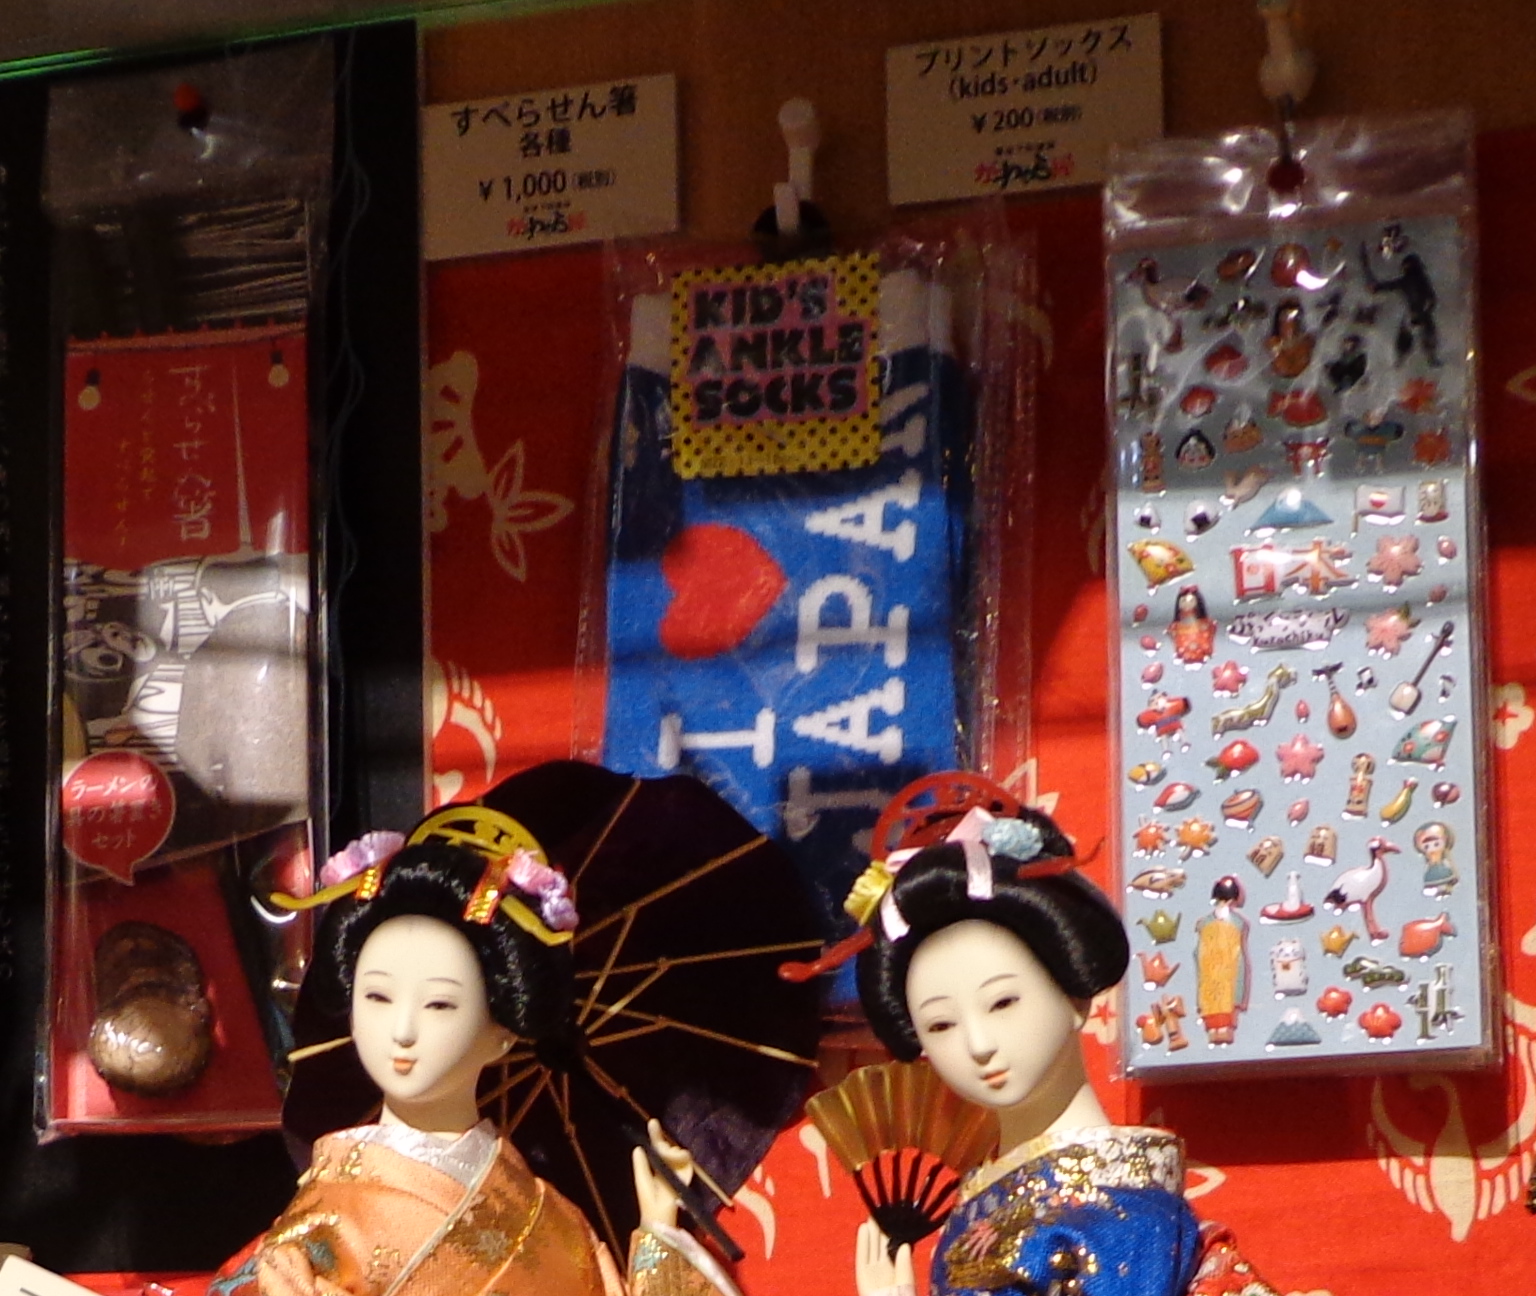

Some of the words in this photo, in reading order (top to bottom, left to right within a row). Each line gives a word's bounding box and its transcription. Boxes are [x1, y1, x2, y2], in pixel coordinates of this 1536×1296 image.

[520, 128, 571, 157] 各種
[692, 275, 829, 329] KID'S
[689, 324, 864, 373] ANKLE
[692, 368, 858, 421] SOCKS
